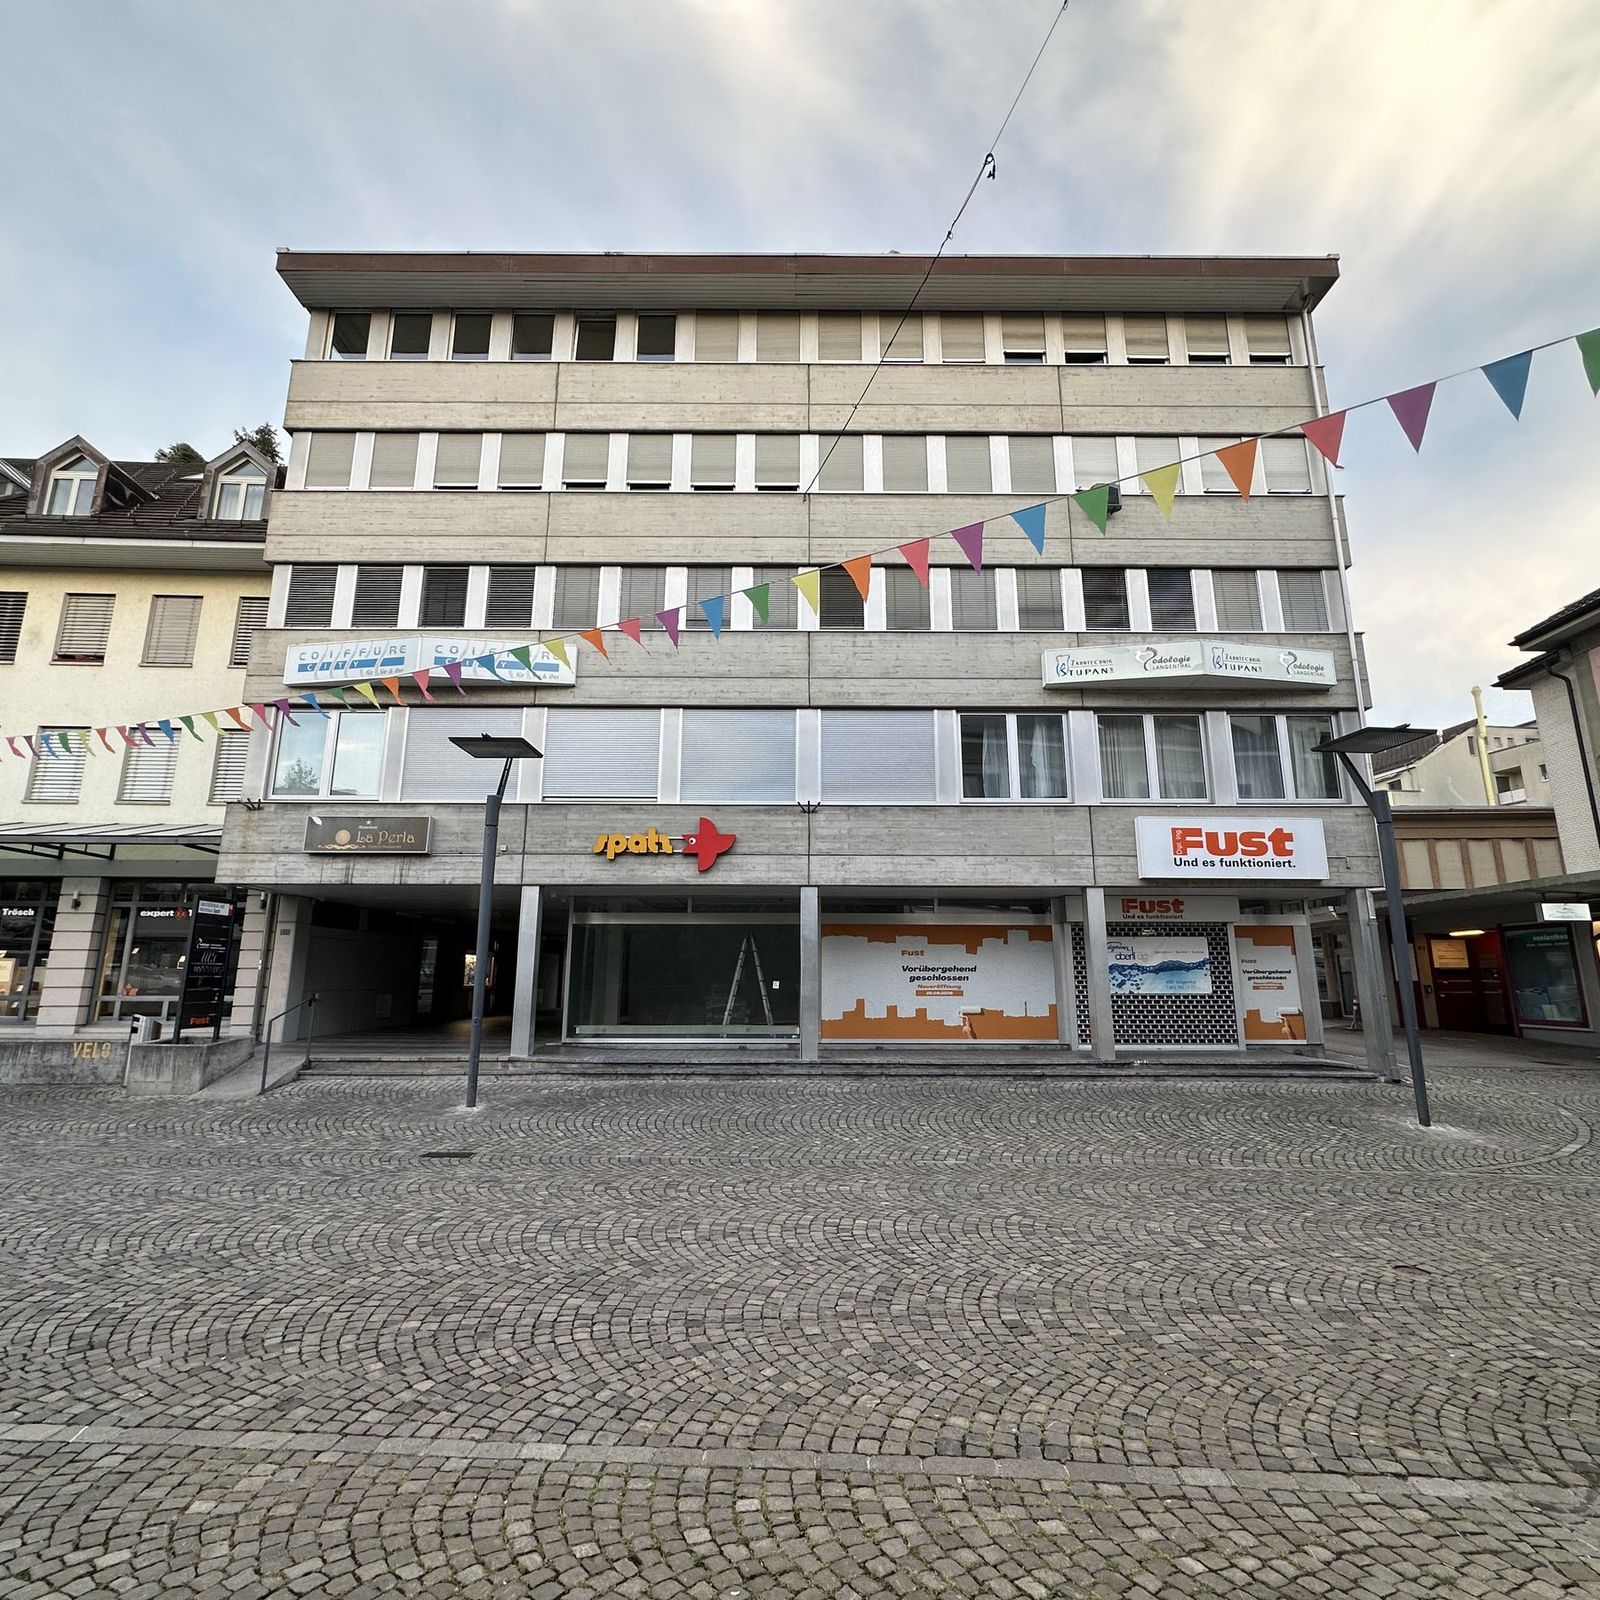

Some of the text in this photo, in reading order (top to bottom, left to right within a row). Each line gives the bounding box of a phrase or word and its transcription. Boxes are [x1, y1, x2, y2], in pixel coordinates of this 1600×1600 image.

[299, 645, 408, 661] COIFFURE
[306, 661, 360, 671] CITY
[445, 658, 506, 668] CIY
[1152, 663, 1192, 671] LANGENTHAL
[356, 830, 415, 846] La Perla
[1171, 827, 1294, 857] Fust
[1174, 857, 1296, 869] Und es funktioniert.
[1121, 898, 1184, 913] Fust
[2, 908, 35, 916] Trösch
[140, 910, 174, 918] expert
[901, 949, 926, 957] Fust
[901, 965, 977, 974] Vorübergehend
[909, 974, 969, 982] geschlossen
